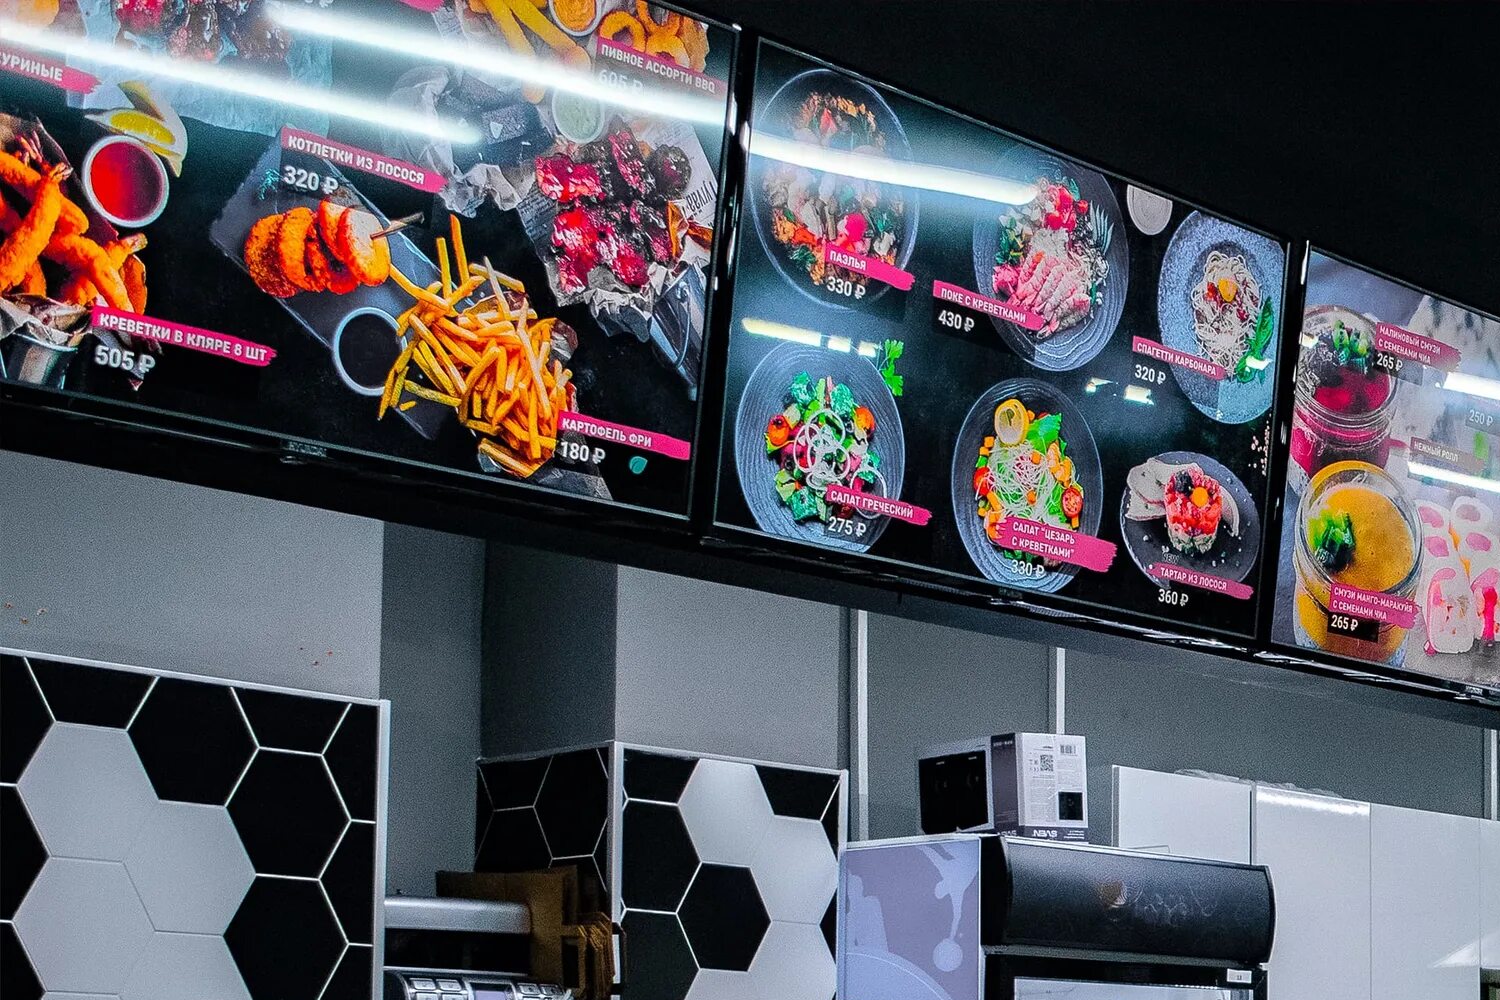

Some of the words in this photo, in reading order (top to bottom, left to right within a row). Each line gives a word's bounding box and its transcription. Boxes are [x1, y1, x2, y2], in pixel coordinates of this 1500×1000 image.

[0, 53, 63, 82] УРИНЫЕ
[601, 44, 644, 70] ПИВНОЕ
[645, 61, 694, 86] АССОРТИ
[695, 78, 716, 95] BBQ
[288, 135, 353, 166] КОТЛЕТКИ
[356, 154, 374, 171] ИЗ
[375, 161, 425, 185] ЛОСОСЯ
[284, 165, 320, 190] 320
[829, 250, 867, 271] ПАЭЛЬЯ
[827, 276, 852, 298] 330
[941, 287, 964, 305] ПОКЕ
[965, 297, 972, 307] С
[972, 298, 1027, 324] КРЕВЕТКАМИ
[938, 310, 962, 330] 430
[100, 312, 172, 341] КРЕВЕТКИ
[174, 328, 183, 344] В
[186, 334, 231, 355] КЛЯРЕ
[234, 343, 243, 357] 8
[245, 345, 267, 362] ШТ
[1379, 325, 1420, 346] МАЛИНОВЫЙ
[1420, 339, 1441, 355] СМУЗИ
[95, 345, 135, 371] 505
[1137, 341, 1174, 364] СПАГЕТТИ
[1175, 352, 1217, 377] КАРБОНАРА
[1384, 341, 1418, 359] СЕМЕНАМИ
[1376, 353, 1394, 371] 265
[1135, 364, 1155, 383] 320
[1469, 409, 1485, 424] 250
[562, 417, 626, 443] КАРТОФЕЛЬ
[629, 433, 652, 449] ФРИ
[561, 440, 590, 462] 180
[830, 490, 862, 508] САЛАТ
[863, 496, 914, 519] ГРЕЧЕСКИЙ
[828, 516, 853, 535] 275
[1012, 521, 1040, 536] САЛАТ
[1011, 536, 1018, 546] С
[1011, 559, 1033, 577] 330
[1160, 567, 1187, 581] ТАРТАР
[1188, 574, 1198, 584] ИЗ
[1199, 576, 1228, 591] ЛОСОСЯ
[1158, 588, 1179, 606] 360
[1334, 586, 1356, 600] СМУЗИ
[1338, 602, 1374, 617] СЕМЕНАМИ
[1374, 609, 1387, 620] ЧИА
[1331, 614, 1349, 630] 265
